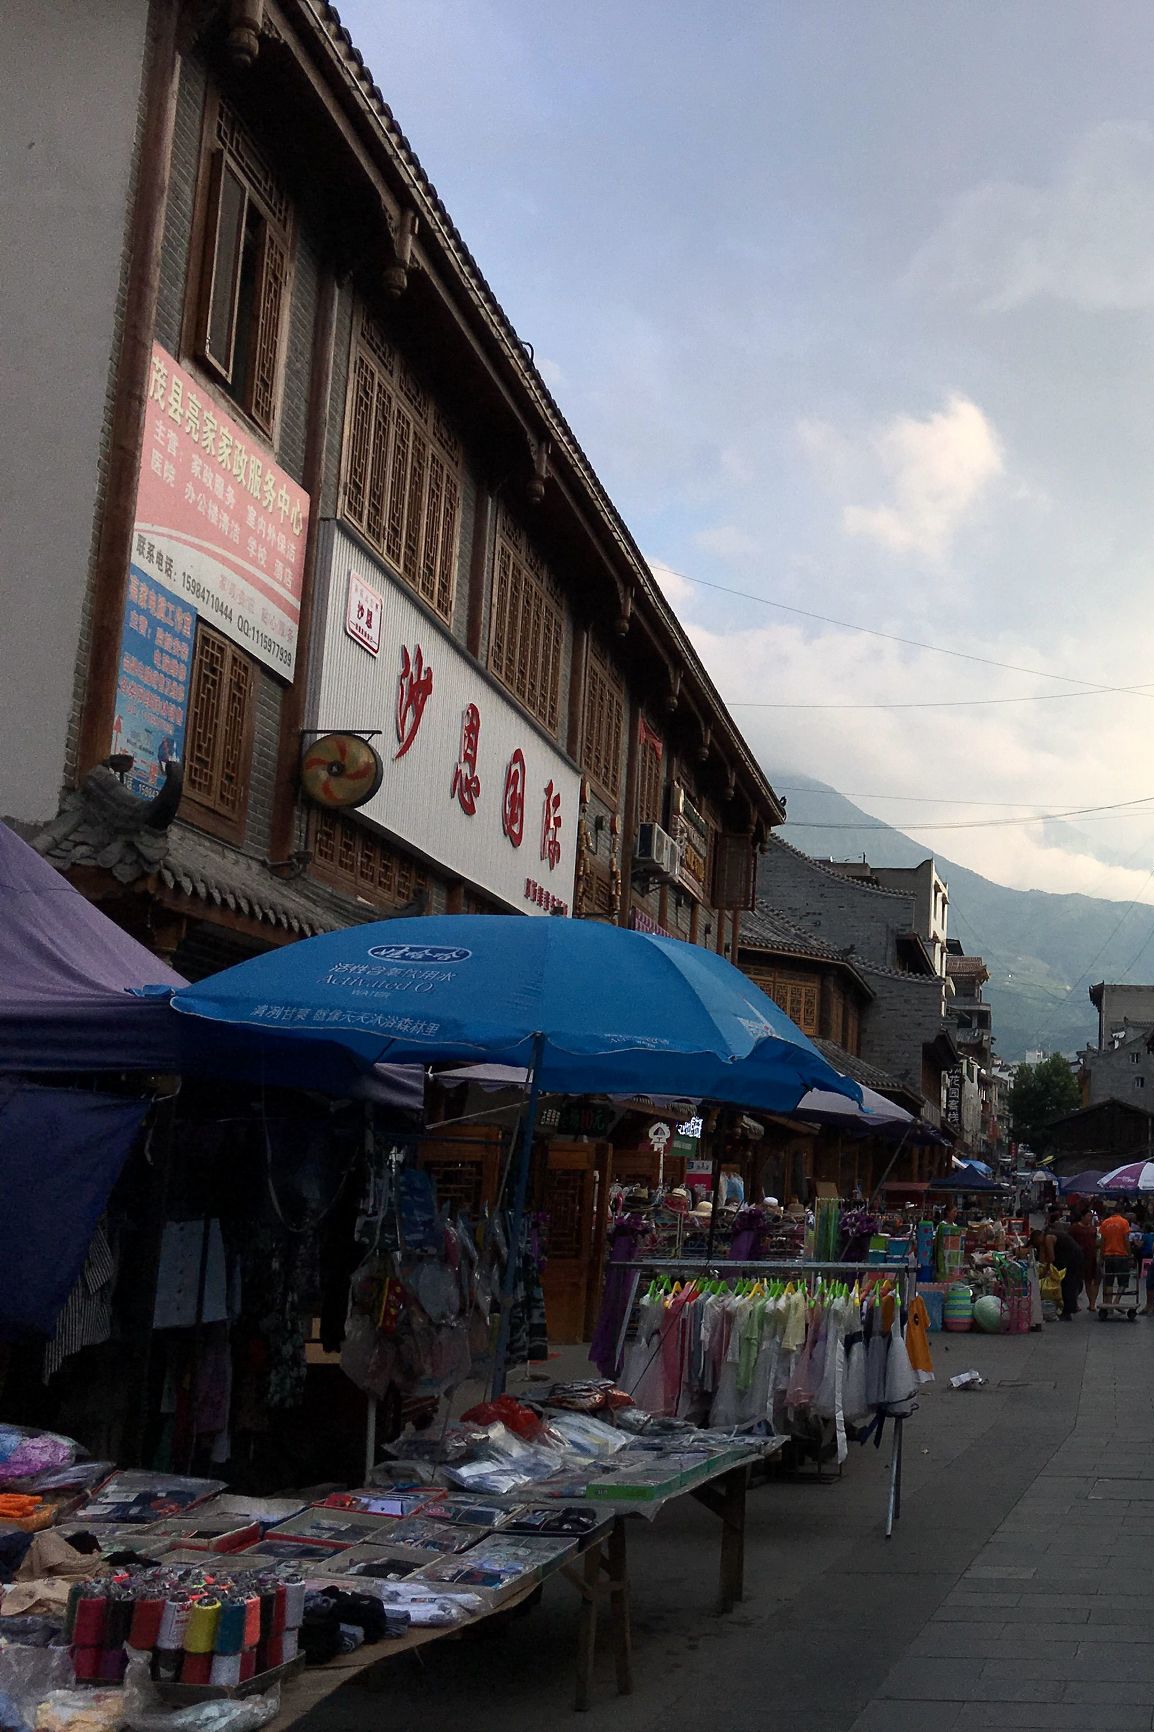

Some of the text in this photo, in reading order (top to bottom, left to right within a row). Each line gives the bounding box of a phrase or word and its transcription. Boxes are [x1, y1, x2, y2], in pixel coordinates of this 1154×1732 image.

[149, 355, 303, 536] 茂县亮家家政服务中心
[182, 571, 234, 624] 15984710444
